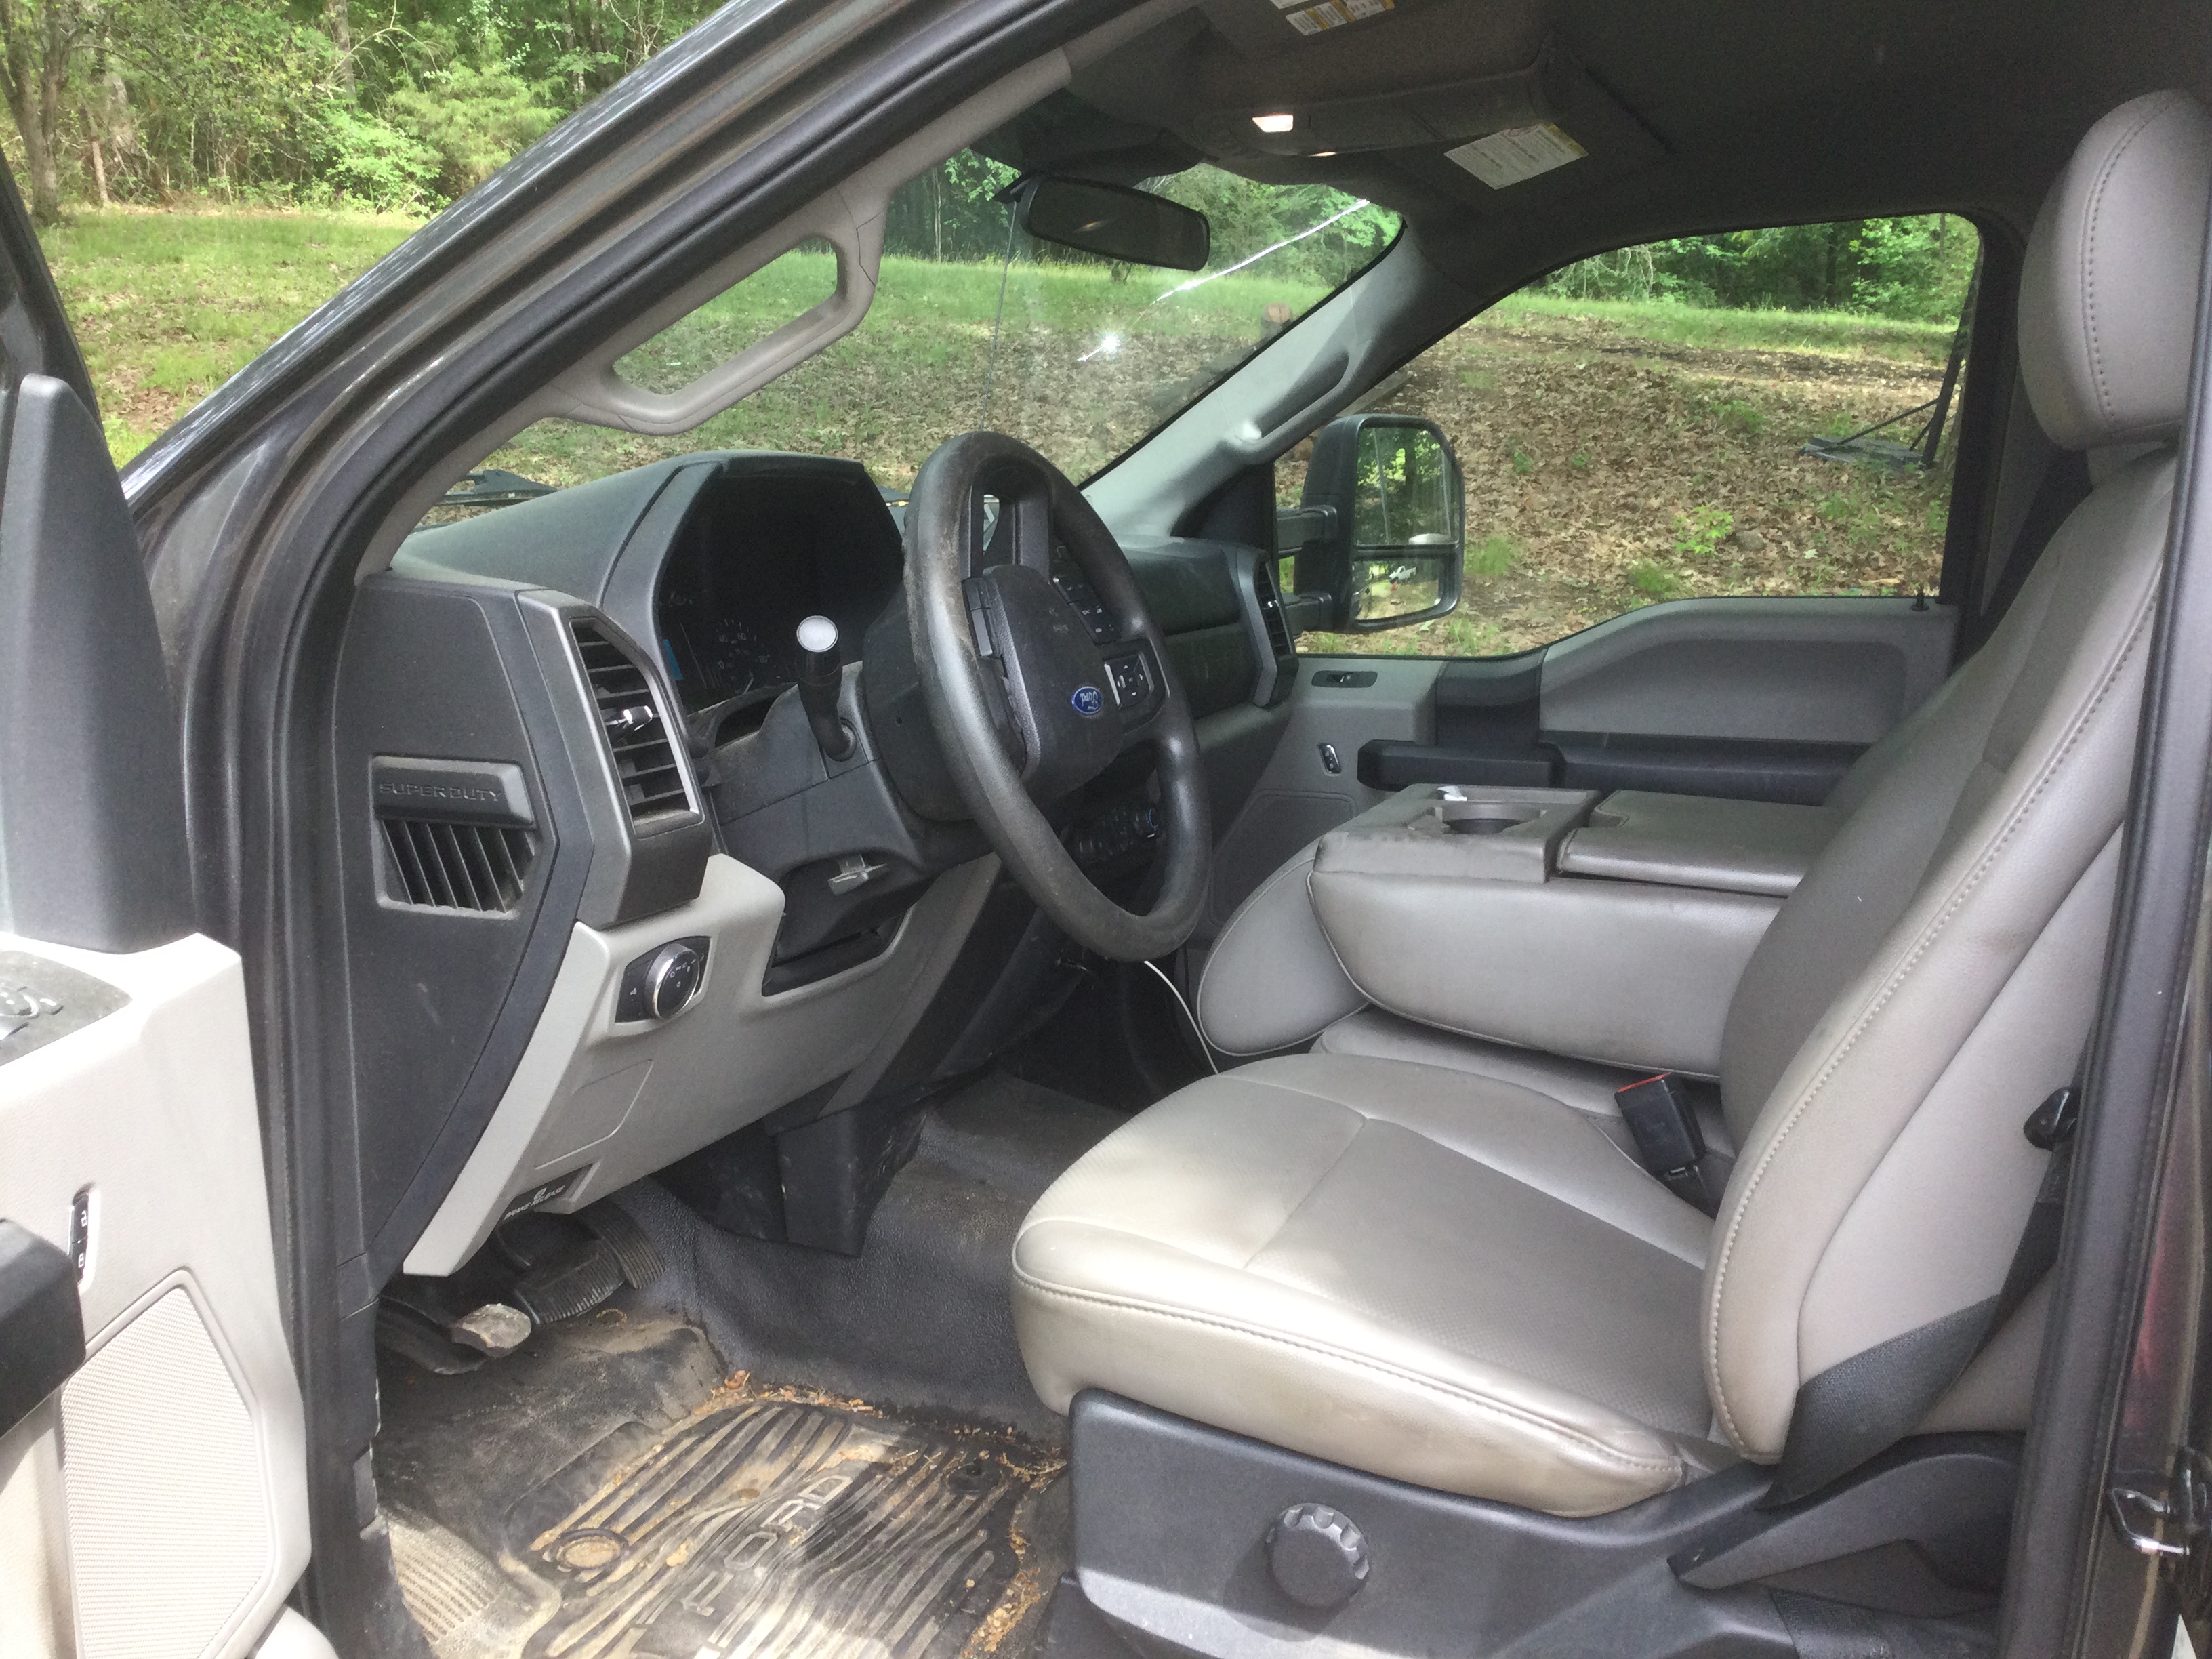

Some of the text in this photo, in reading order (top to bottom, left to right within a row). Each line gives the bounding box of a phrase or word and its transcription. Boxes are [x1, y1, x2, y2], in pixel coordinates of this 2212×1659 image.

[1078, 689, 1100, 712] Ford
[378, 781, 504, 802] SUPER DUTY
[681, 1474, 854, 1618] FORD
